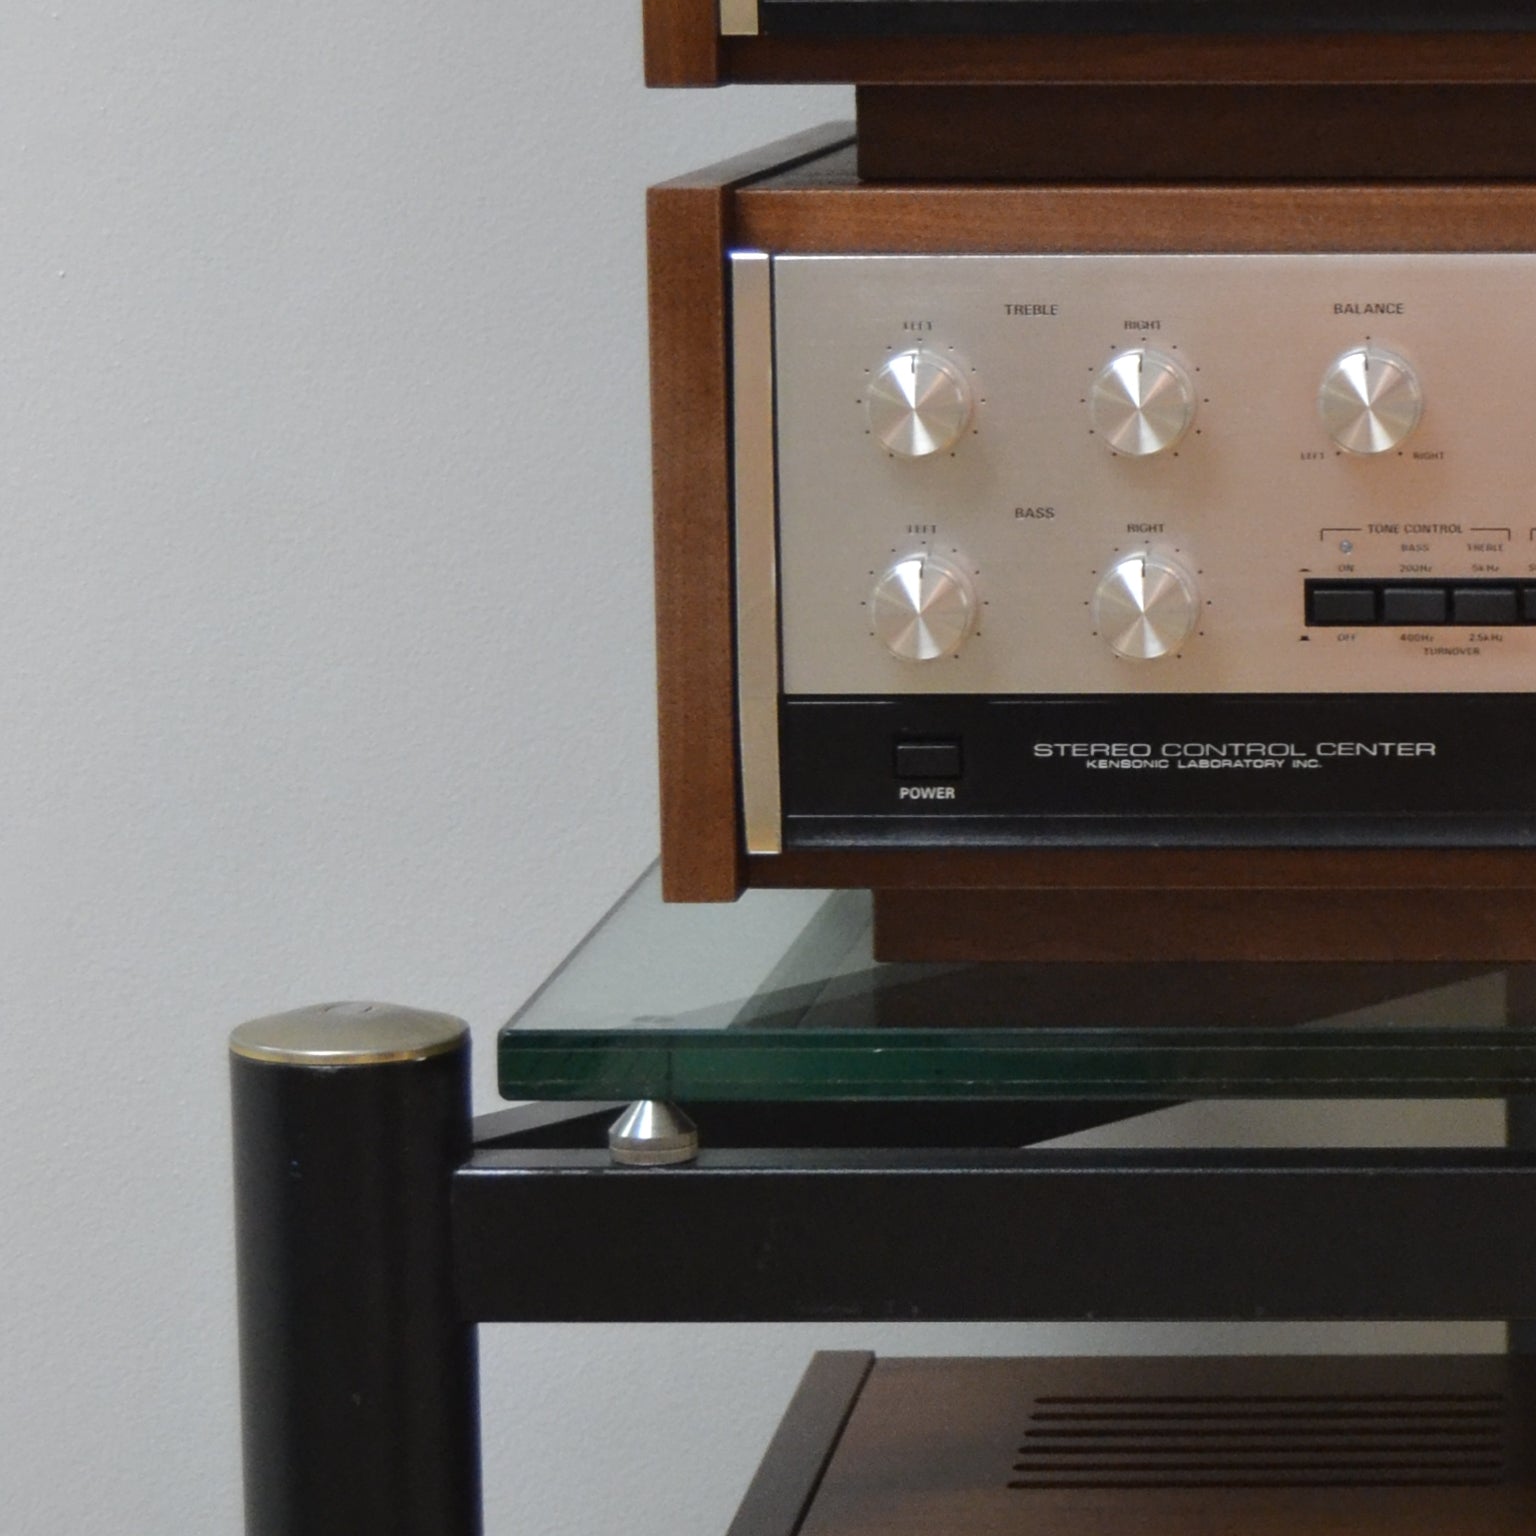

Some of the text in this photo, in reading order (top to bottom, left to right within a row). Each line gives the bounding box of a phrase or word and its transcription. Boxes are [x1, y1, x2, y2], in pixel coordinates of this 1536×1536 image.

[1005, 304, 1058, 315] TREBLE
[1334, 303, 1404, 314] BALANCE
[1124, 321, 1161, 330] RIGHT
[1014, 508, 1056, 519] BASS
[1127, 523, 1164, 533] RIGHT
[1368, 524, 1463, 534] TONE CONTROL
[1402, 544, 1429, 552] BASS
[1338, 564, 1354, 572] ON
[1034, 742, 1435, 757] STEREO CONTROL CENTER
[1086, 759, 1169, 769] KENSONIC
[1178, 759, 1284, 769] LABORATORY
[900, 788, 955, 800] POWER
